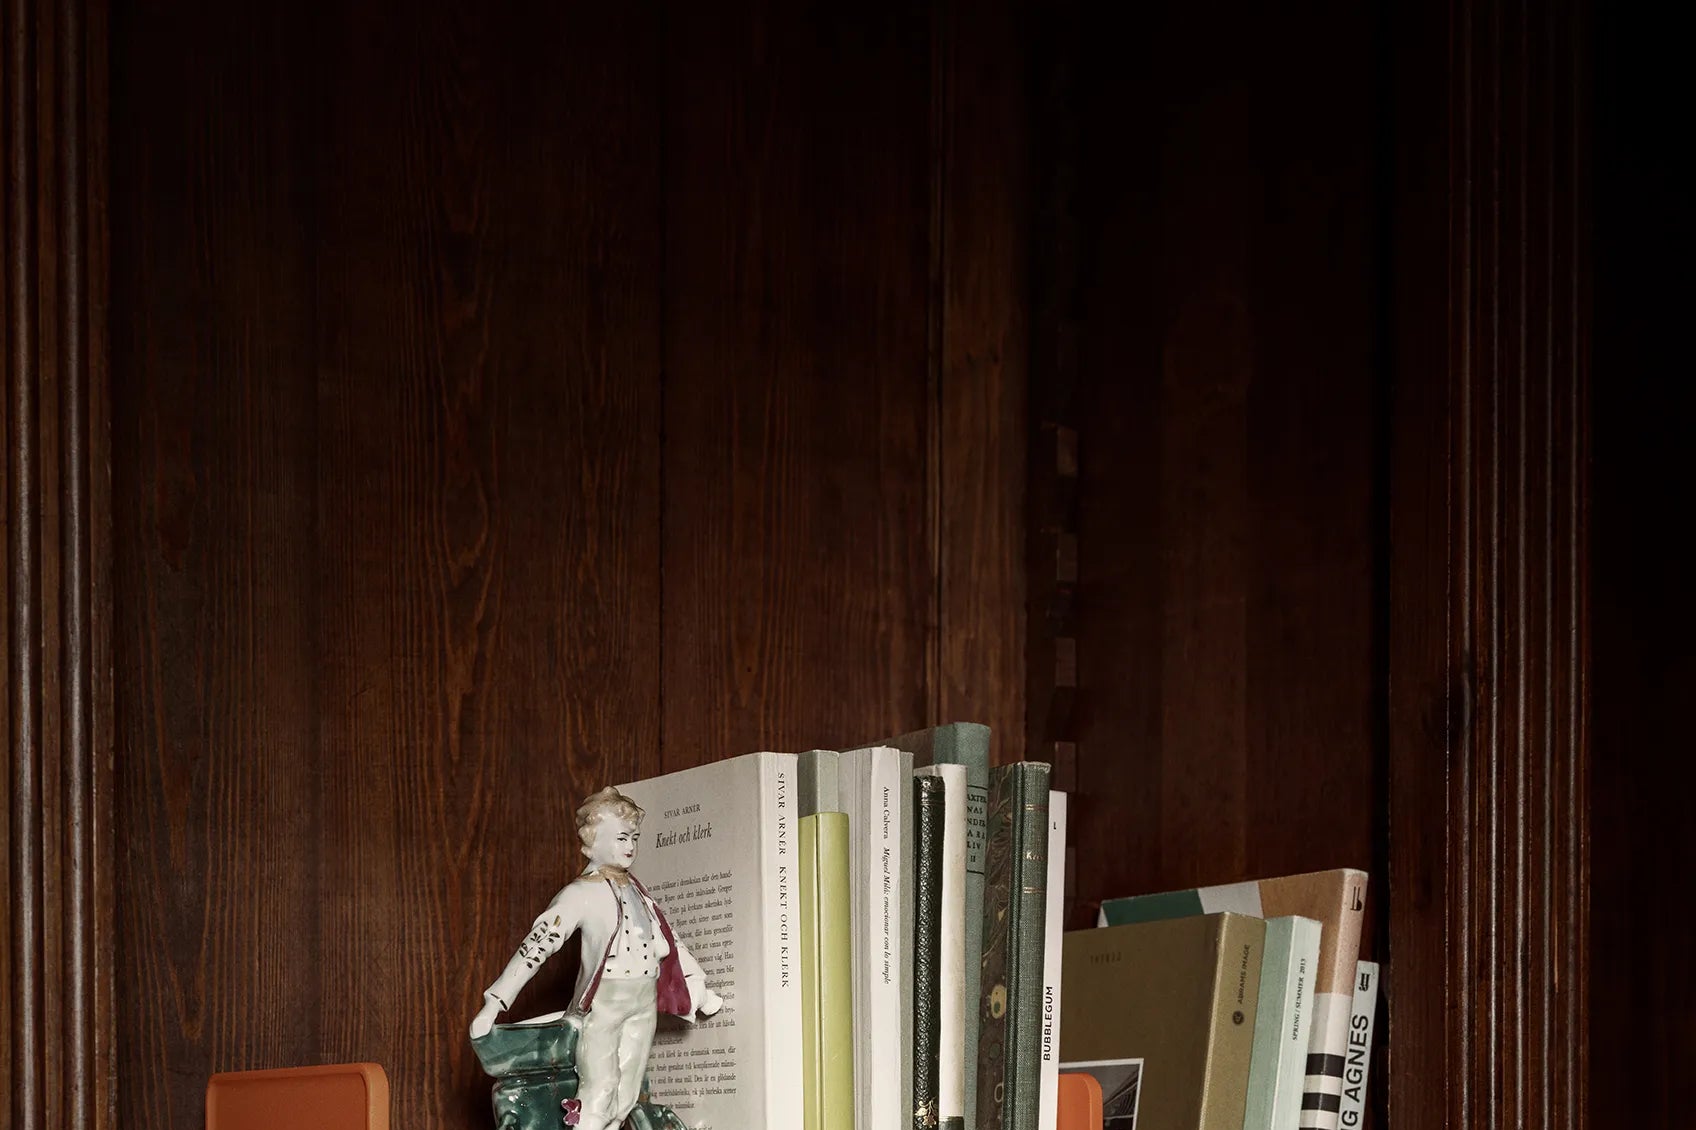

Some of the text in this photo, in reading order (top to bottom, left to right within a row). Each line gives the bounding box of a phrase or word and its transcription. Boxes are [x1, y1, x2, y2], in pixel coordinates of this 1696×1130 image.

[778, 772, 786, 809] SIVAR
[664, 807, 680, 819] SIVAR
[656, 822, 713, 849] Knekt och klerk
[883, 847, 891, 875] Miguel
[779, 866, 790, 988] KNEKT OCH KLERK
[882, 960, 891, 985] simple
[1241, 944, 1251, 970] IMAGE
[1043, 986, 1053, 1061] BUBBLEGUM
[1292, 1013, 1300, 1041] SPRING
[1296, 977, 1304, 1009] SUMMER
[1345, 1014, 1368, 1103] AGNES
